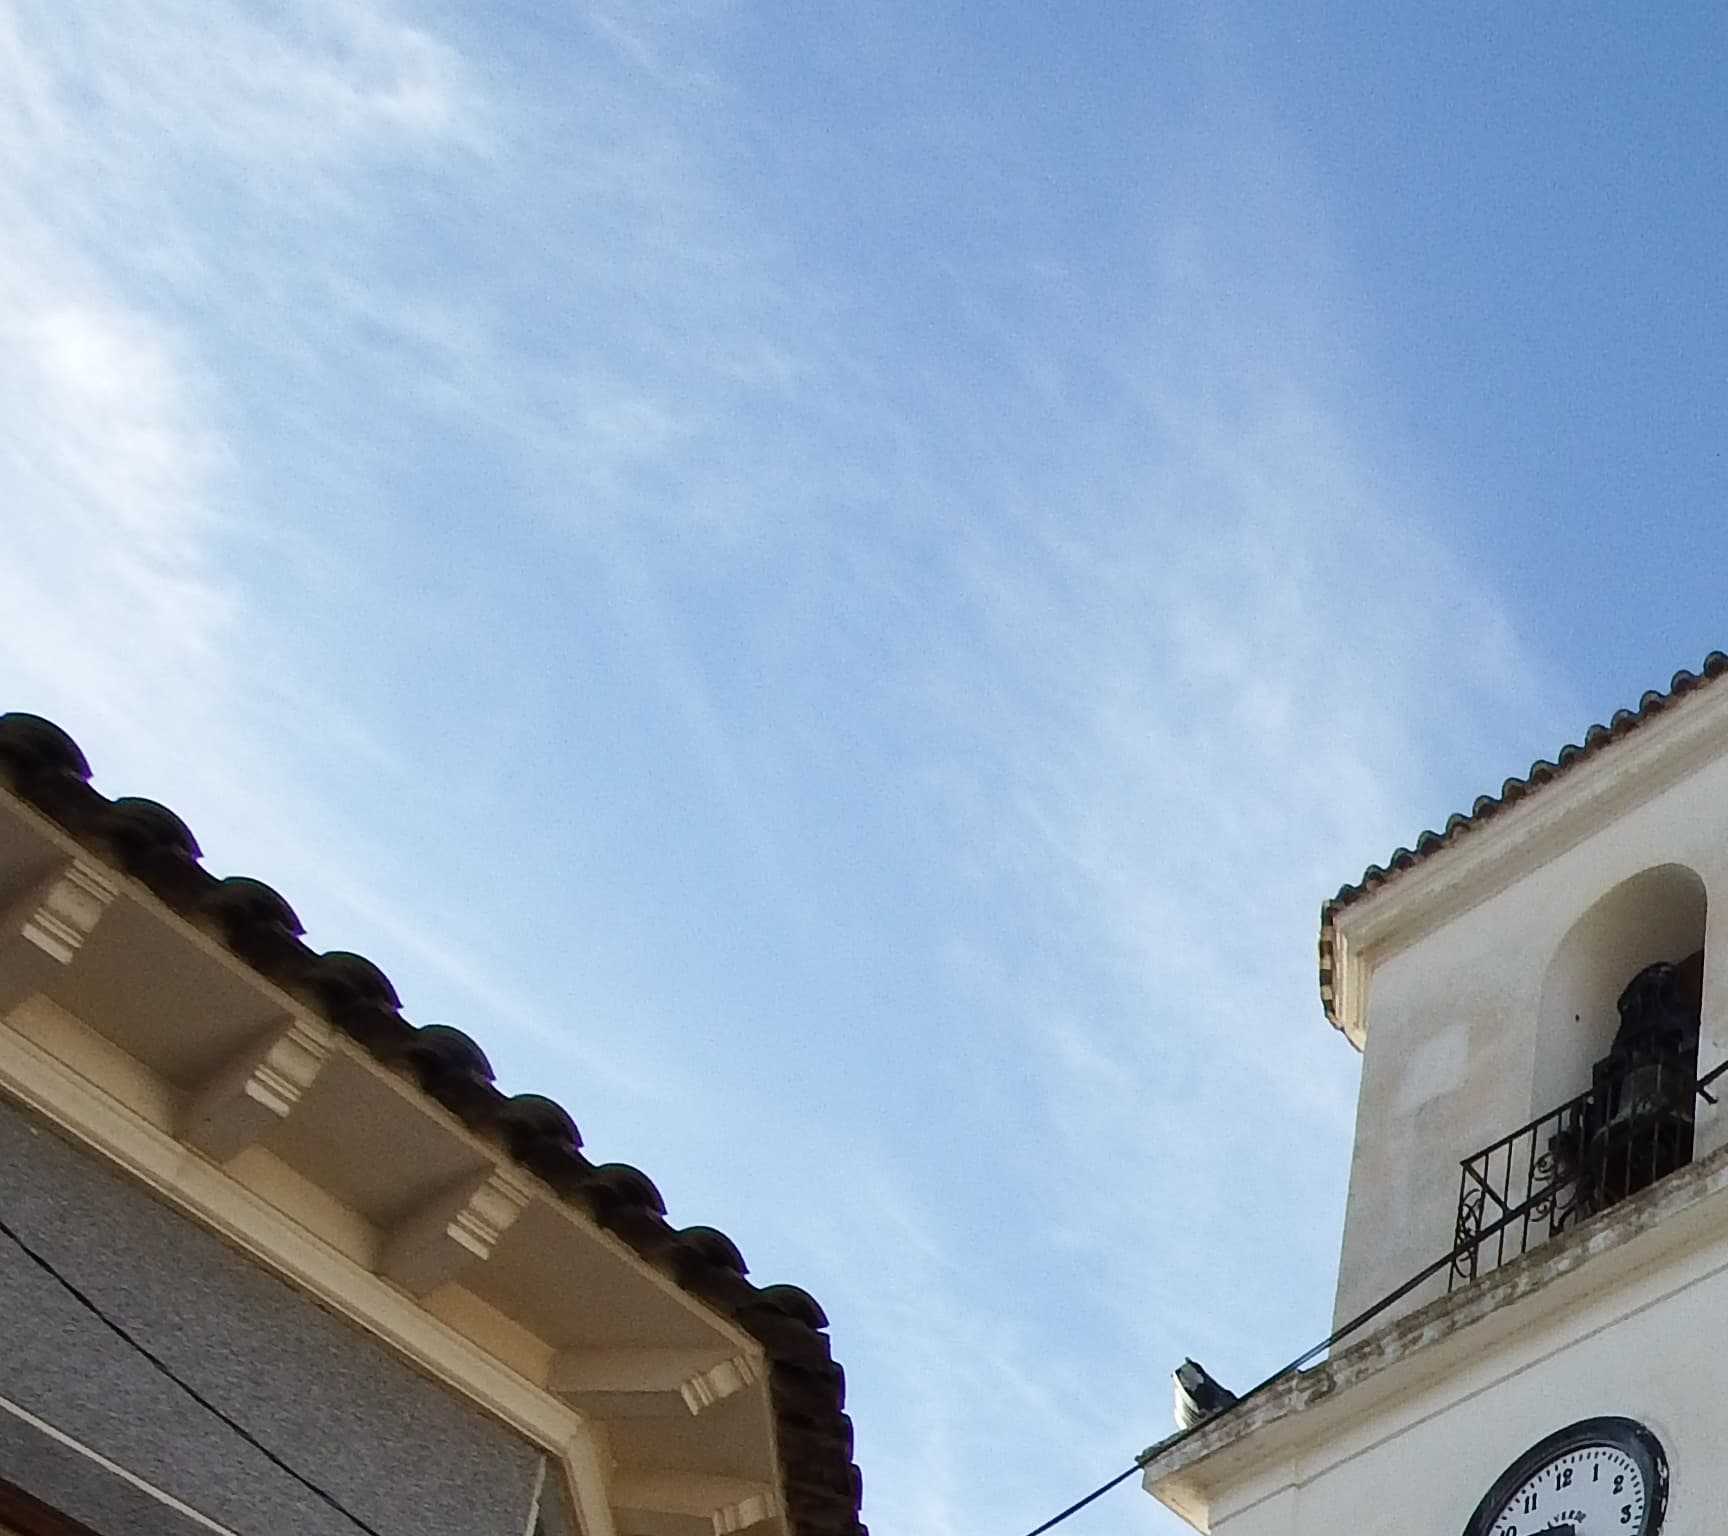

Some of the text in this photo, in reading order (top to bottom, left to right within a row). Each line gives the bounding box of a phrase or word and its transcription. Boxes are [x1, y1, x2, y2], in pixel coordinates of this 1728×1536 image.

[1555, 1468, 1573, 1491] 12
[1592, 1464, 1600, 1482] 1
[1612, 1475, 1625, 1494] 2
[1523, 1493, 1538, 1514] 11
[1620, 1504, 1632, 1524] 3
